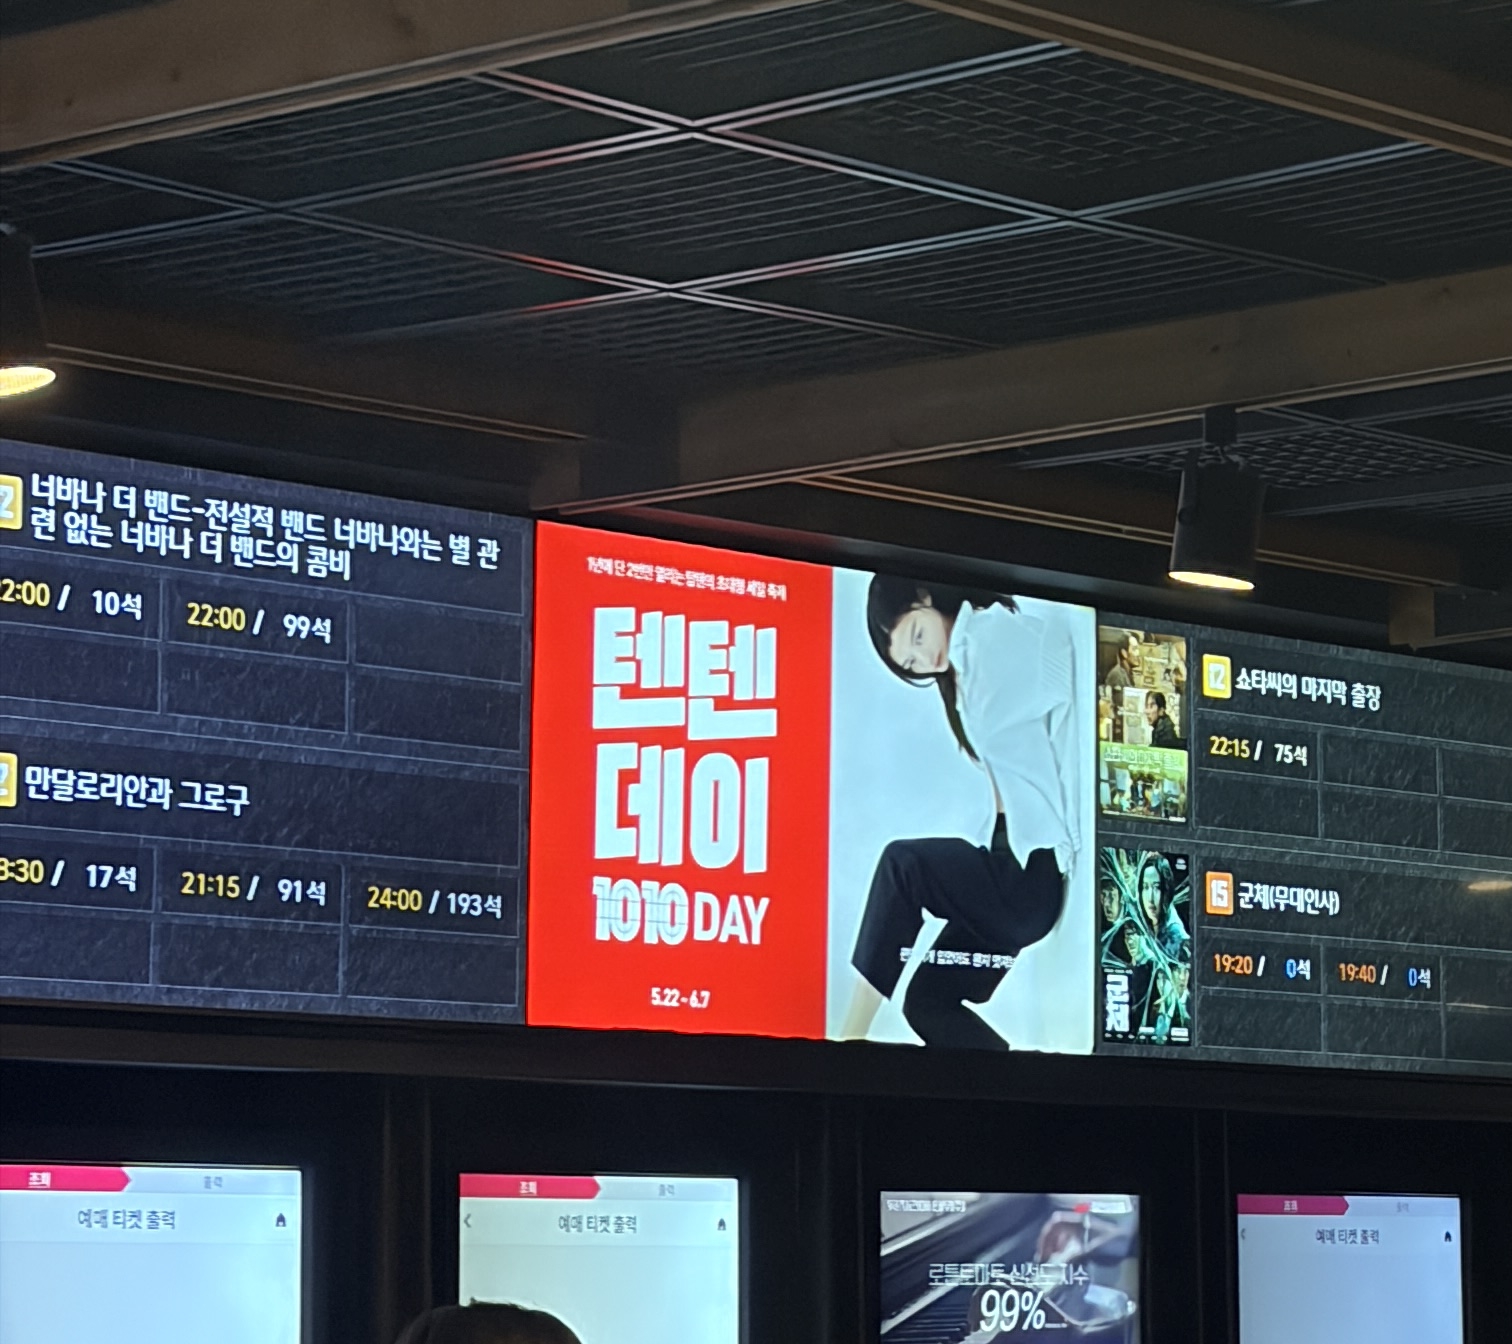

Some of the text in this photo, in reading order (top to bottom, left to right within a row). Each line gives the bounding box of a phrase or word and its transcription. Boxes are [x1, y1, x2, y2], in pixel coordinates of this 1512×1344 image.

[31, 473, 501, 570] 너바나 더 밴드-전설적 밴드 너바나와는 별 관
[31, 506, 351, 581] 련 없는 너바나 더 밴드의 콤비
[0, 578, 50, 607] 2:00
[92, 591, 142, 620] 10석
[187, 603, 246, 632] 22:00
[283, 615, 332, 643] 99석
[592, 606, 777, 741] 텐텐
[1235, 667, 1382, 712] 쇼타씨의 마지막 출장
[1209, 736, 1250, 759] 22:15
[1274, 743, 1308, 767] 75석
[24, 765, 250, 816] 만달로리안과 그로구
[594, 741, 769, 874] 데이
[86, 864, 137, 892] 17석
[181, 872, 240, 899] 21:15
[278, 879, 327, 906] 91석
[367, 886, 423, 912] 24:00
[446, 893, 502, 919] 193석
[1237, 882, 1340, 916] 군체(무대인사)
[1214, 953, 1253, 975] 19:20
[1286, 959, 1312, 981] 0석
[1339, 962, 1377, 984] 19:40
[1408, 967, 1432, 989] 0석
[78, 1208, 176, 1230] 예매 티켓 출력
[558, 1215, 638, 1234] 예매 티켓 출력
[1315, 1228, 1380, 1244] 예매 티켓 출력
[980, 1289, 1046, 1332] 99%
